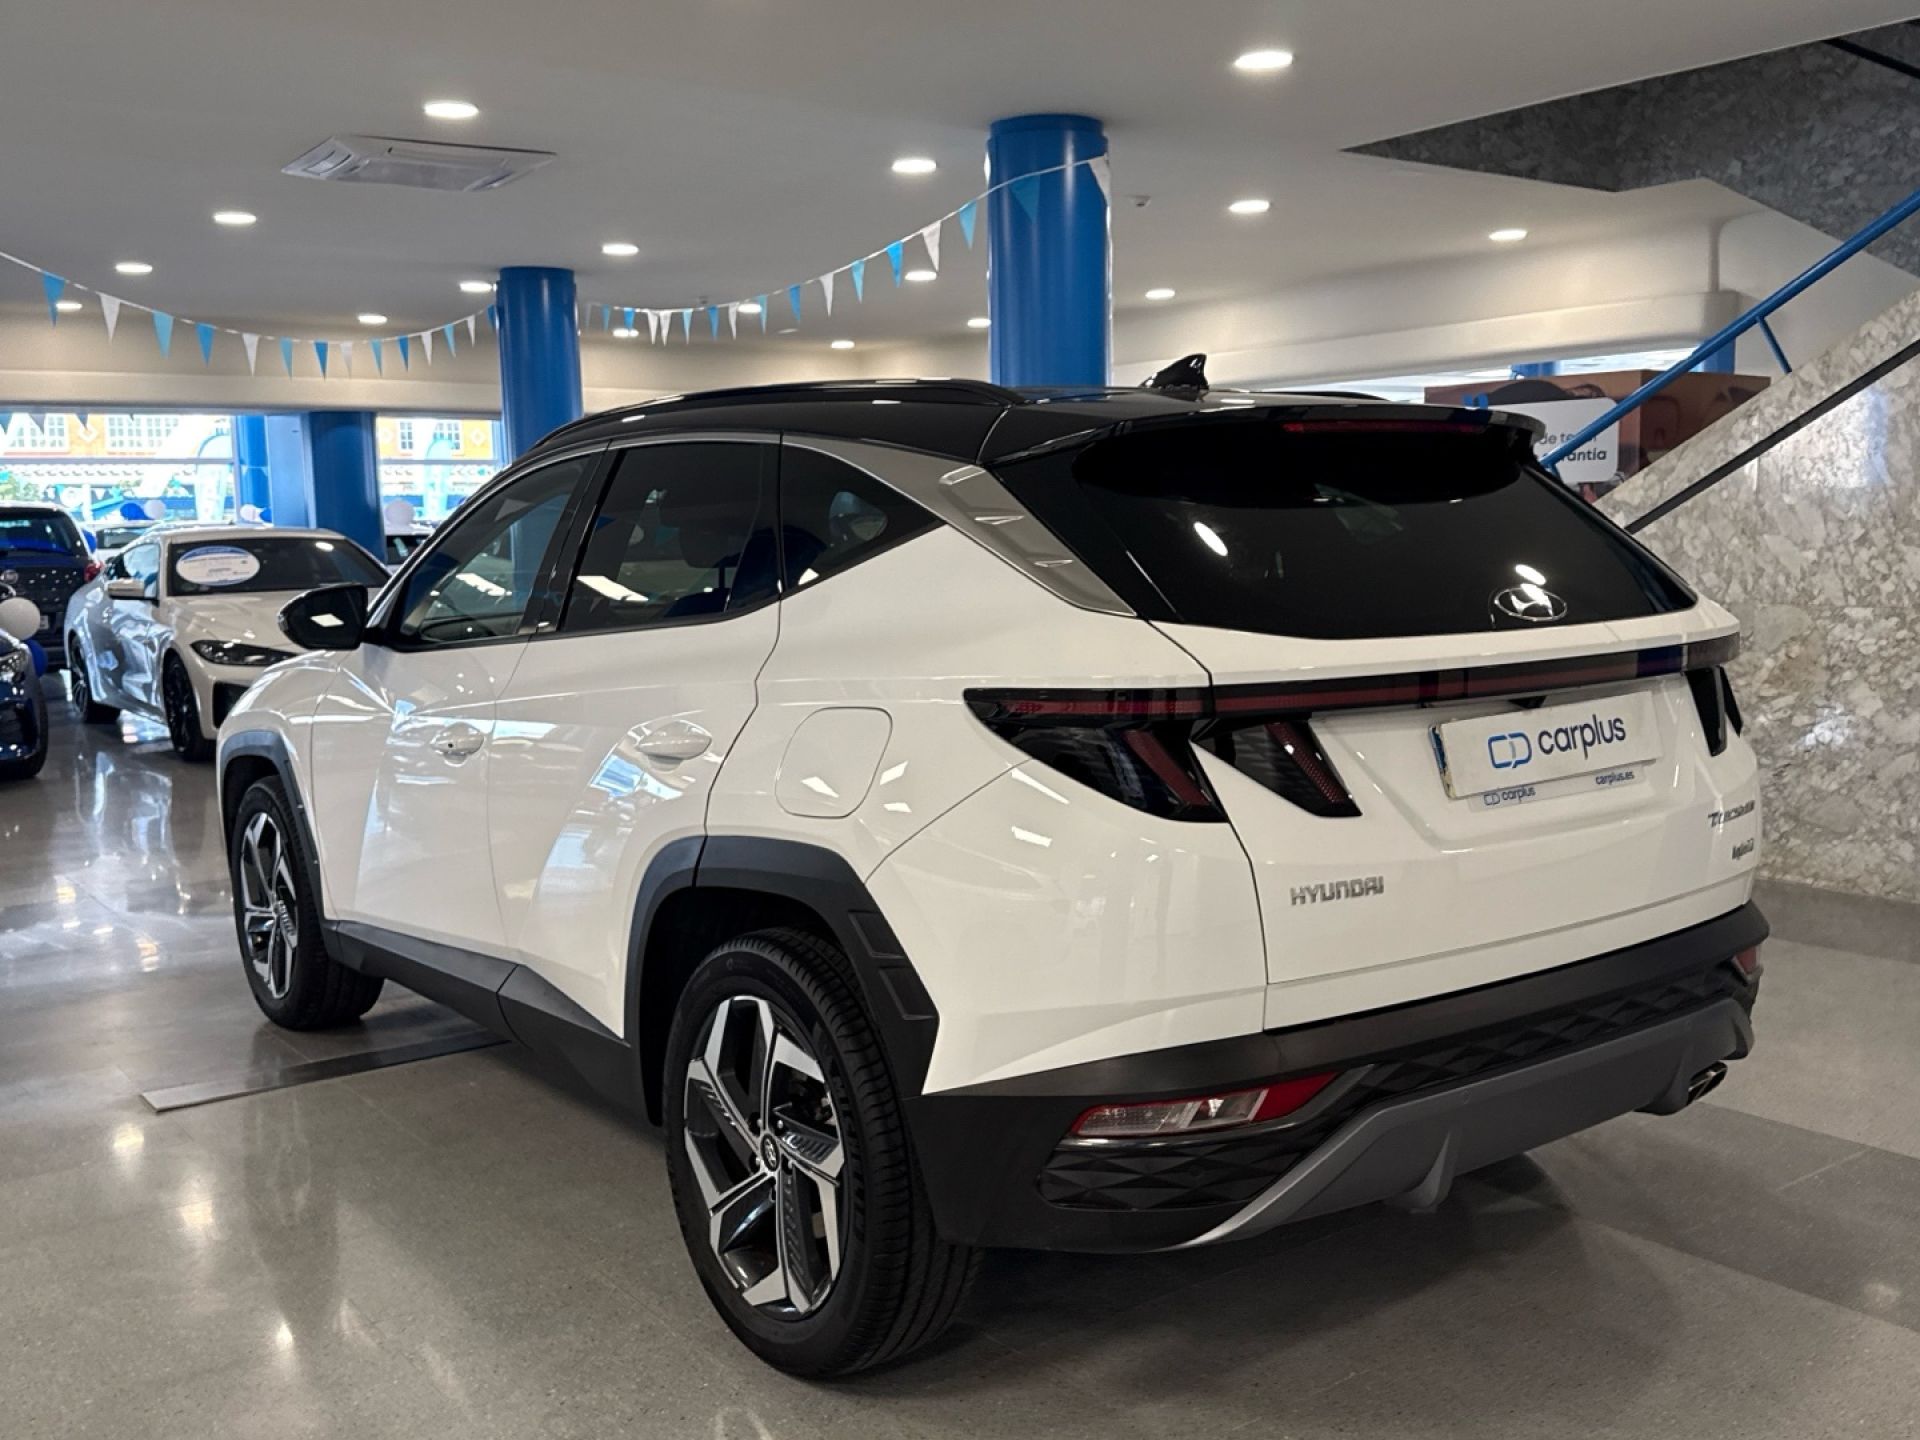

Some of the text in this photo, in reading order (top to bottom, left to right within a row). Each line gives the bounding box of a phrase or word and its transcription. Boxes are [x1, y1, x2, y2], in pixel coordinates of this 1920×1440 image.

[1538, 713, 1626, 760] carplus
[1595, 771, 1635, 786] carplus.es
[1501, 786, 1537, 804] carplus
[1290, 876, 1384, 905] HYUNDAI
